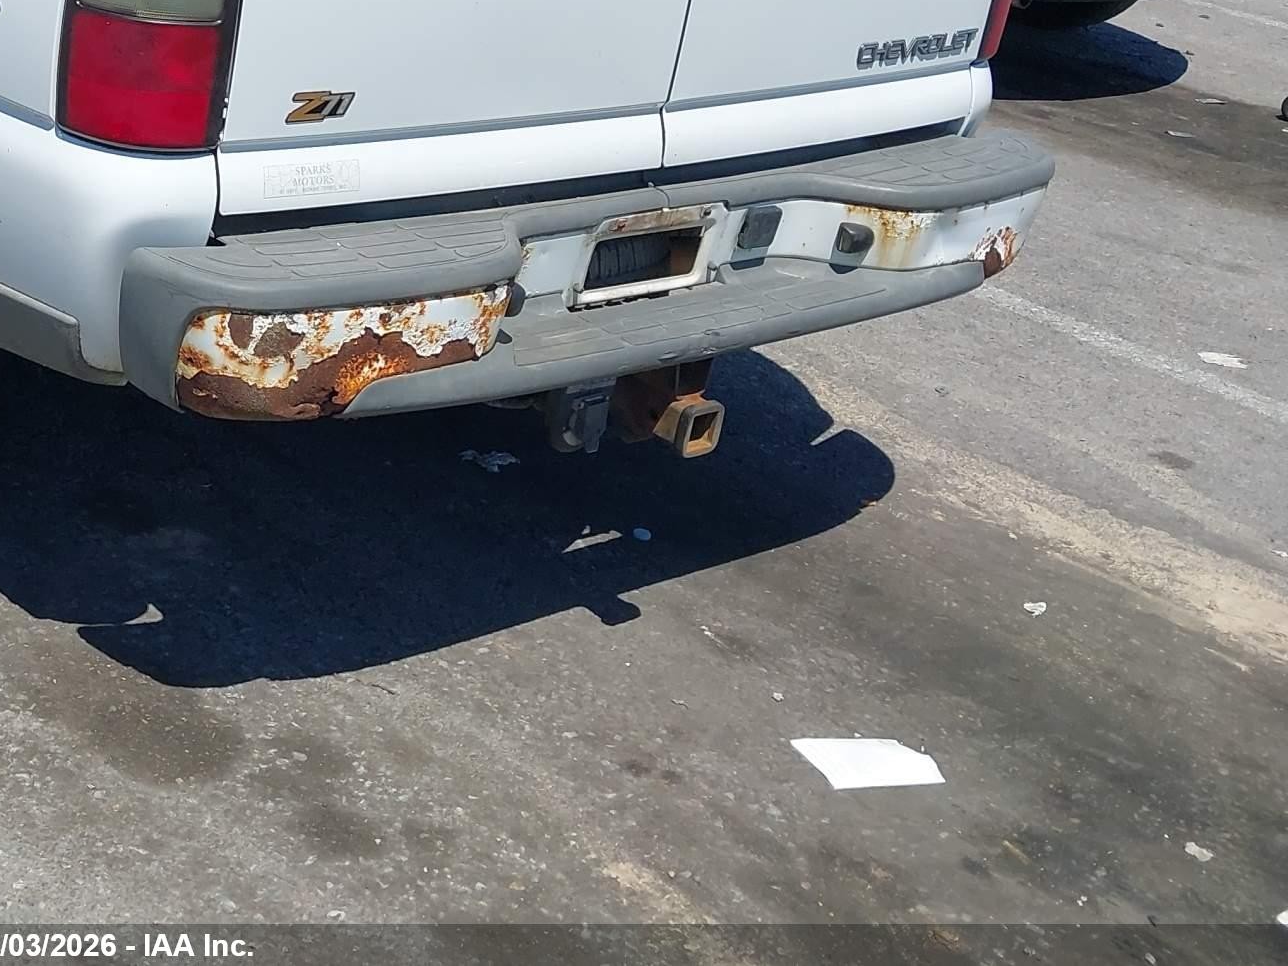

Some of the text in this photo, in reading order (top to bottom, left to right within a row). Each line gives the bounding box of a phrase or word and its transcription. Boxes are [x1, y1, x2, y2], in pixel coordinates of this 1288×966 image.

[856, 28, 979, 70] CHEVROLET
[285, 91, 355, 124] Z71
[295, 161, 331, 176] SPARKS
[292, 175, 336, 187] MOTORS
